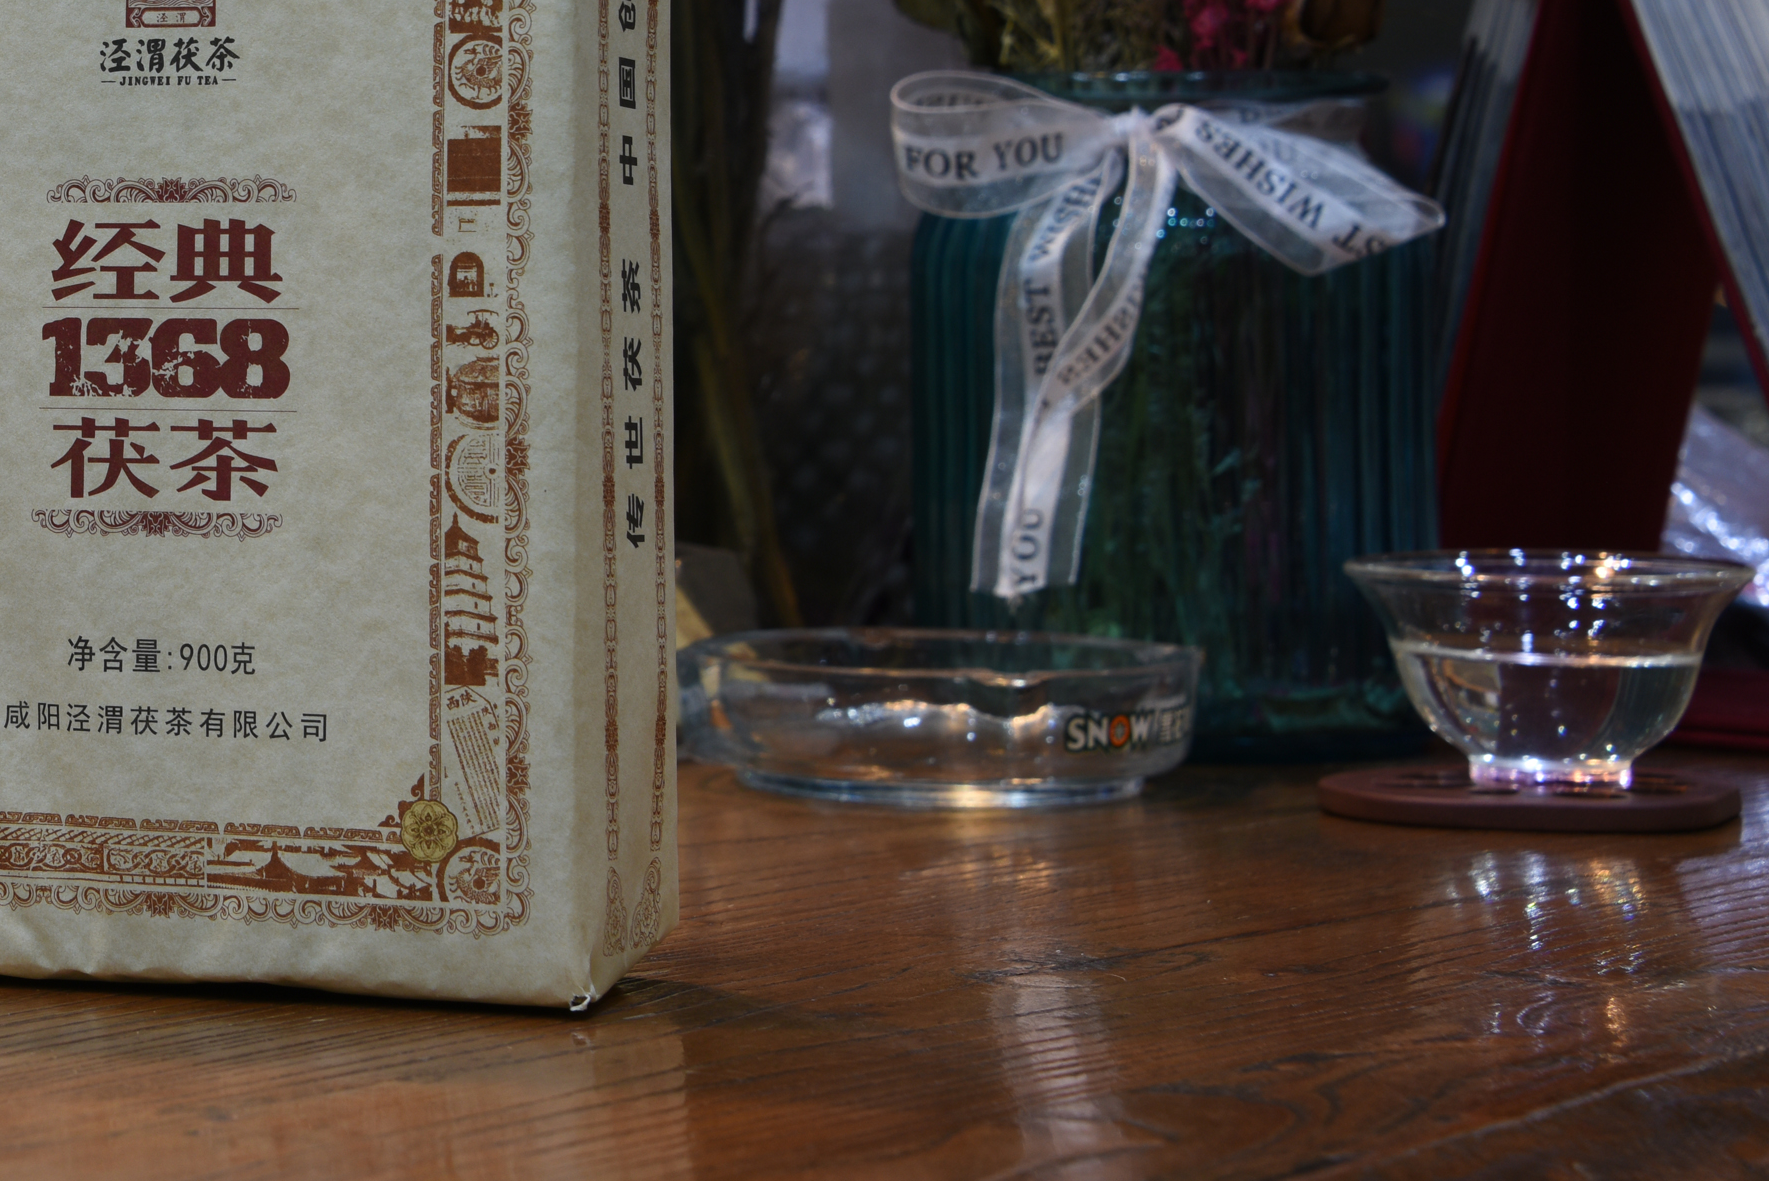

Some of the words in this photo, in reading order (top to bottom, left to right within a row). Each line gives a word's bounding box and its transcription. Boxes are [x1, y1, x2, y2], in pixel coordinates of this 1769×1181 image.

[99, 36, 241, 73] 泾渭茯茶
[119, 75, 171, 86] JINGWEI
[176, 75, 192, 86] FU
[196, 75, 219, 86] TEA
[904, 141, 979, 180] FOR
[993, 130, 1066, 173] YOU
[1194, 119, 1328, 230] WISHES
[50, 219, 283, 304] 经典
[41, 317, 290, 399] 1368
[50, 417, 279, 502] 茯茶
[66, 634, 257, 677] 净含量:900克
[3, 700, 330, 743] 咸阳泾渭茯茶有限公司
[1065, 709, 1152, 753] SNOW
